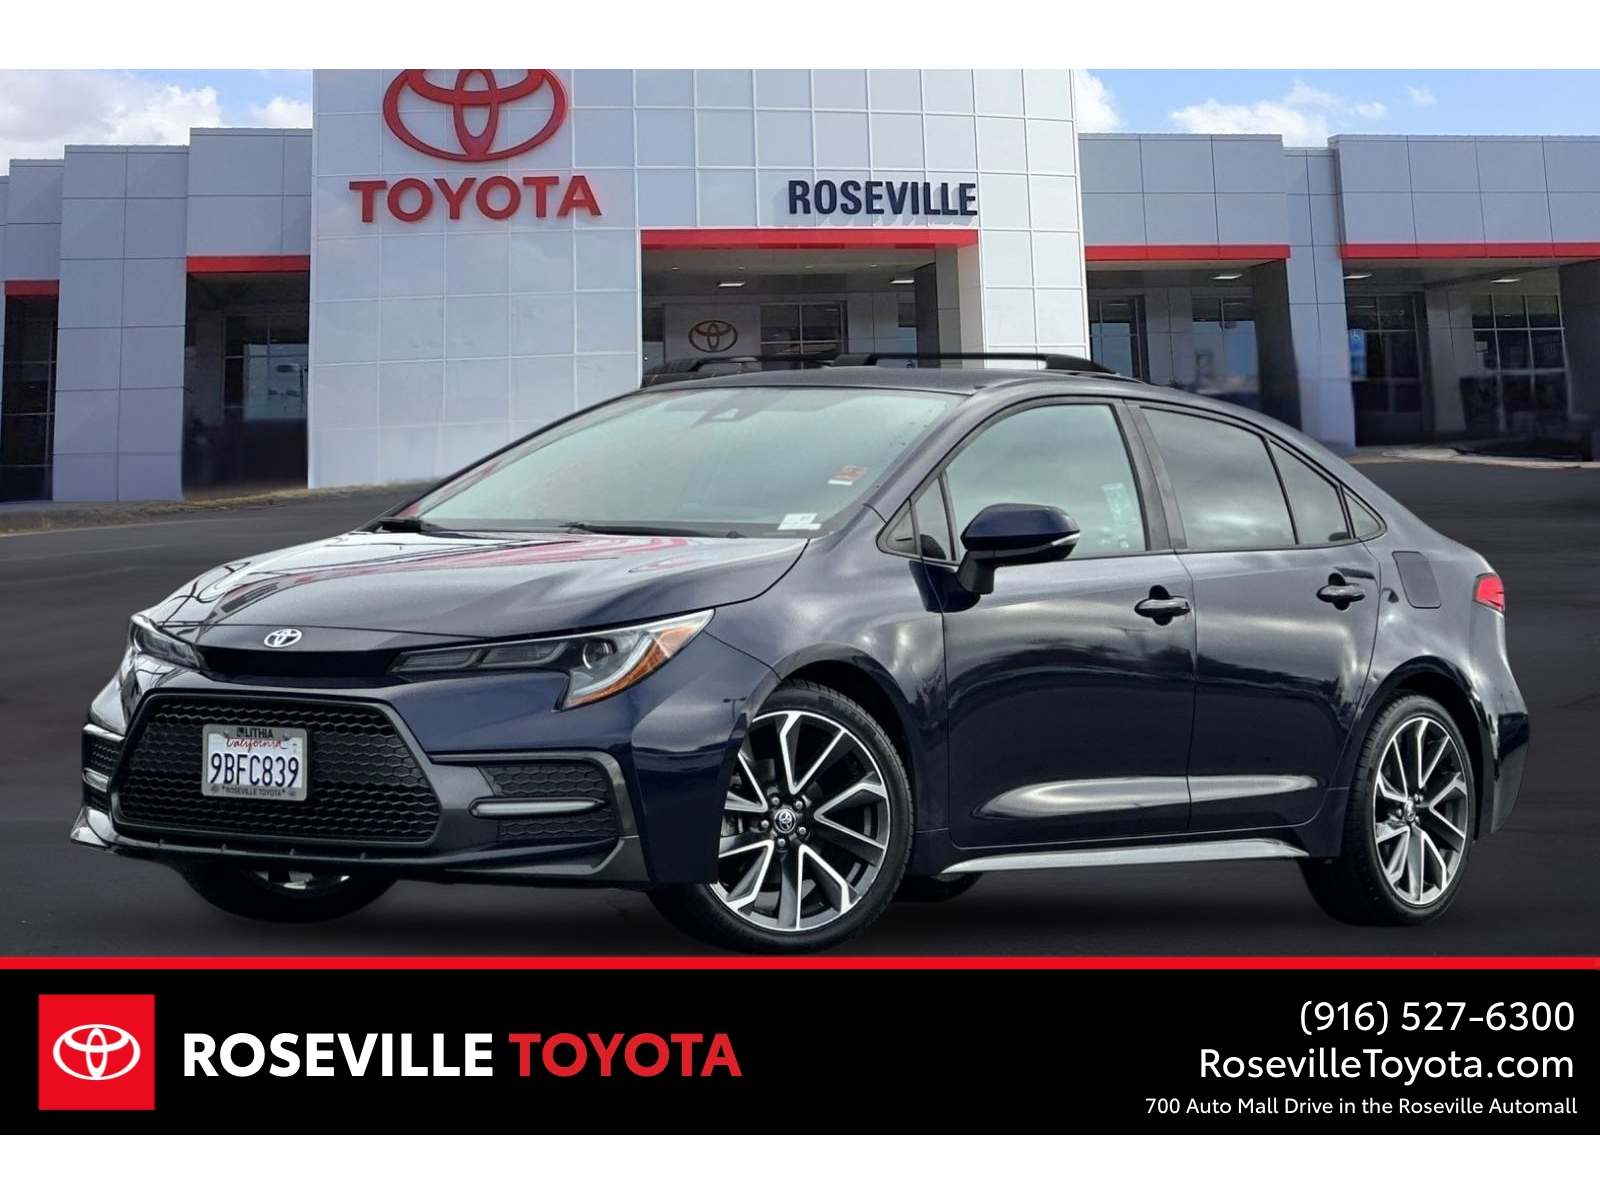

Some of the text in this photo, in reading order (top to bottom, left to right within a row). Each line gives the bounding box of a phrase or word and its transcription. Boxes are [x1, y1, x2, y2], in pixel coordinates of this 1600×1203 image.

[349, 175, 602, 224] TOYOTA
[788, 179, 978, 217] ROSEVILLE
[224, 736, 282, 752] California
[245, 727, 274, 739] LITHIA
[210, 752, 299, 788] 9BFC839
